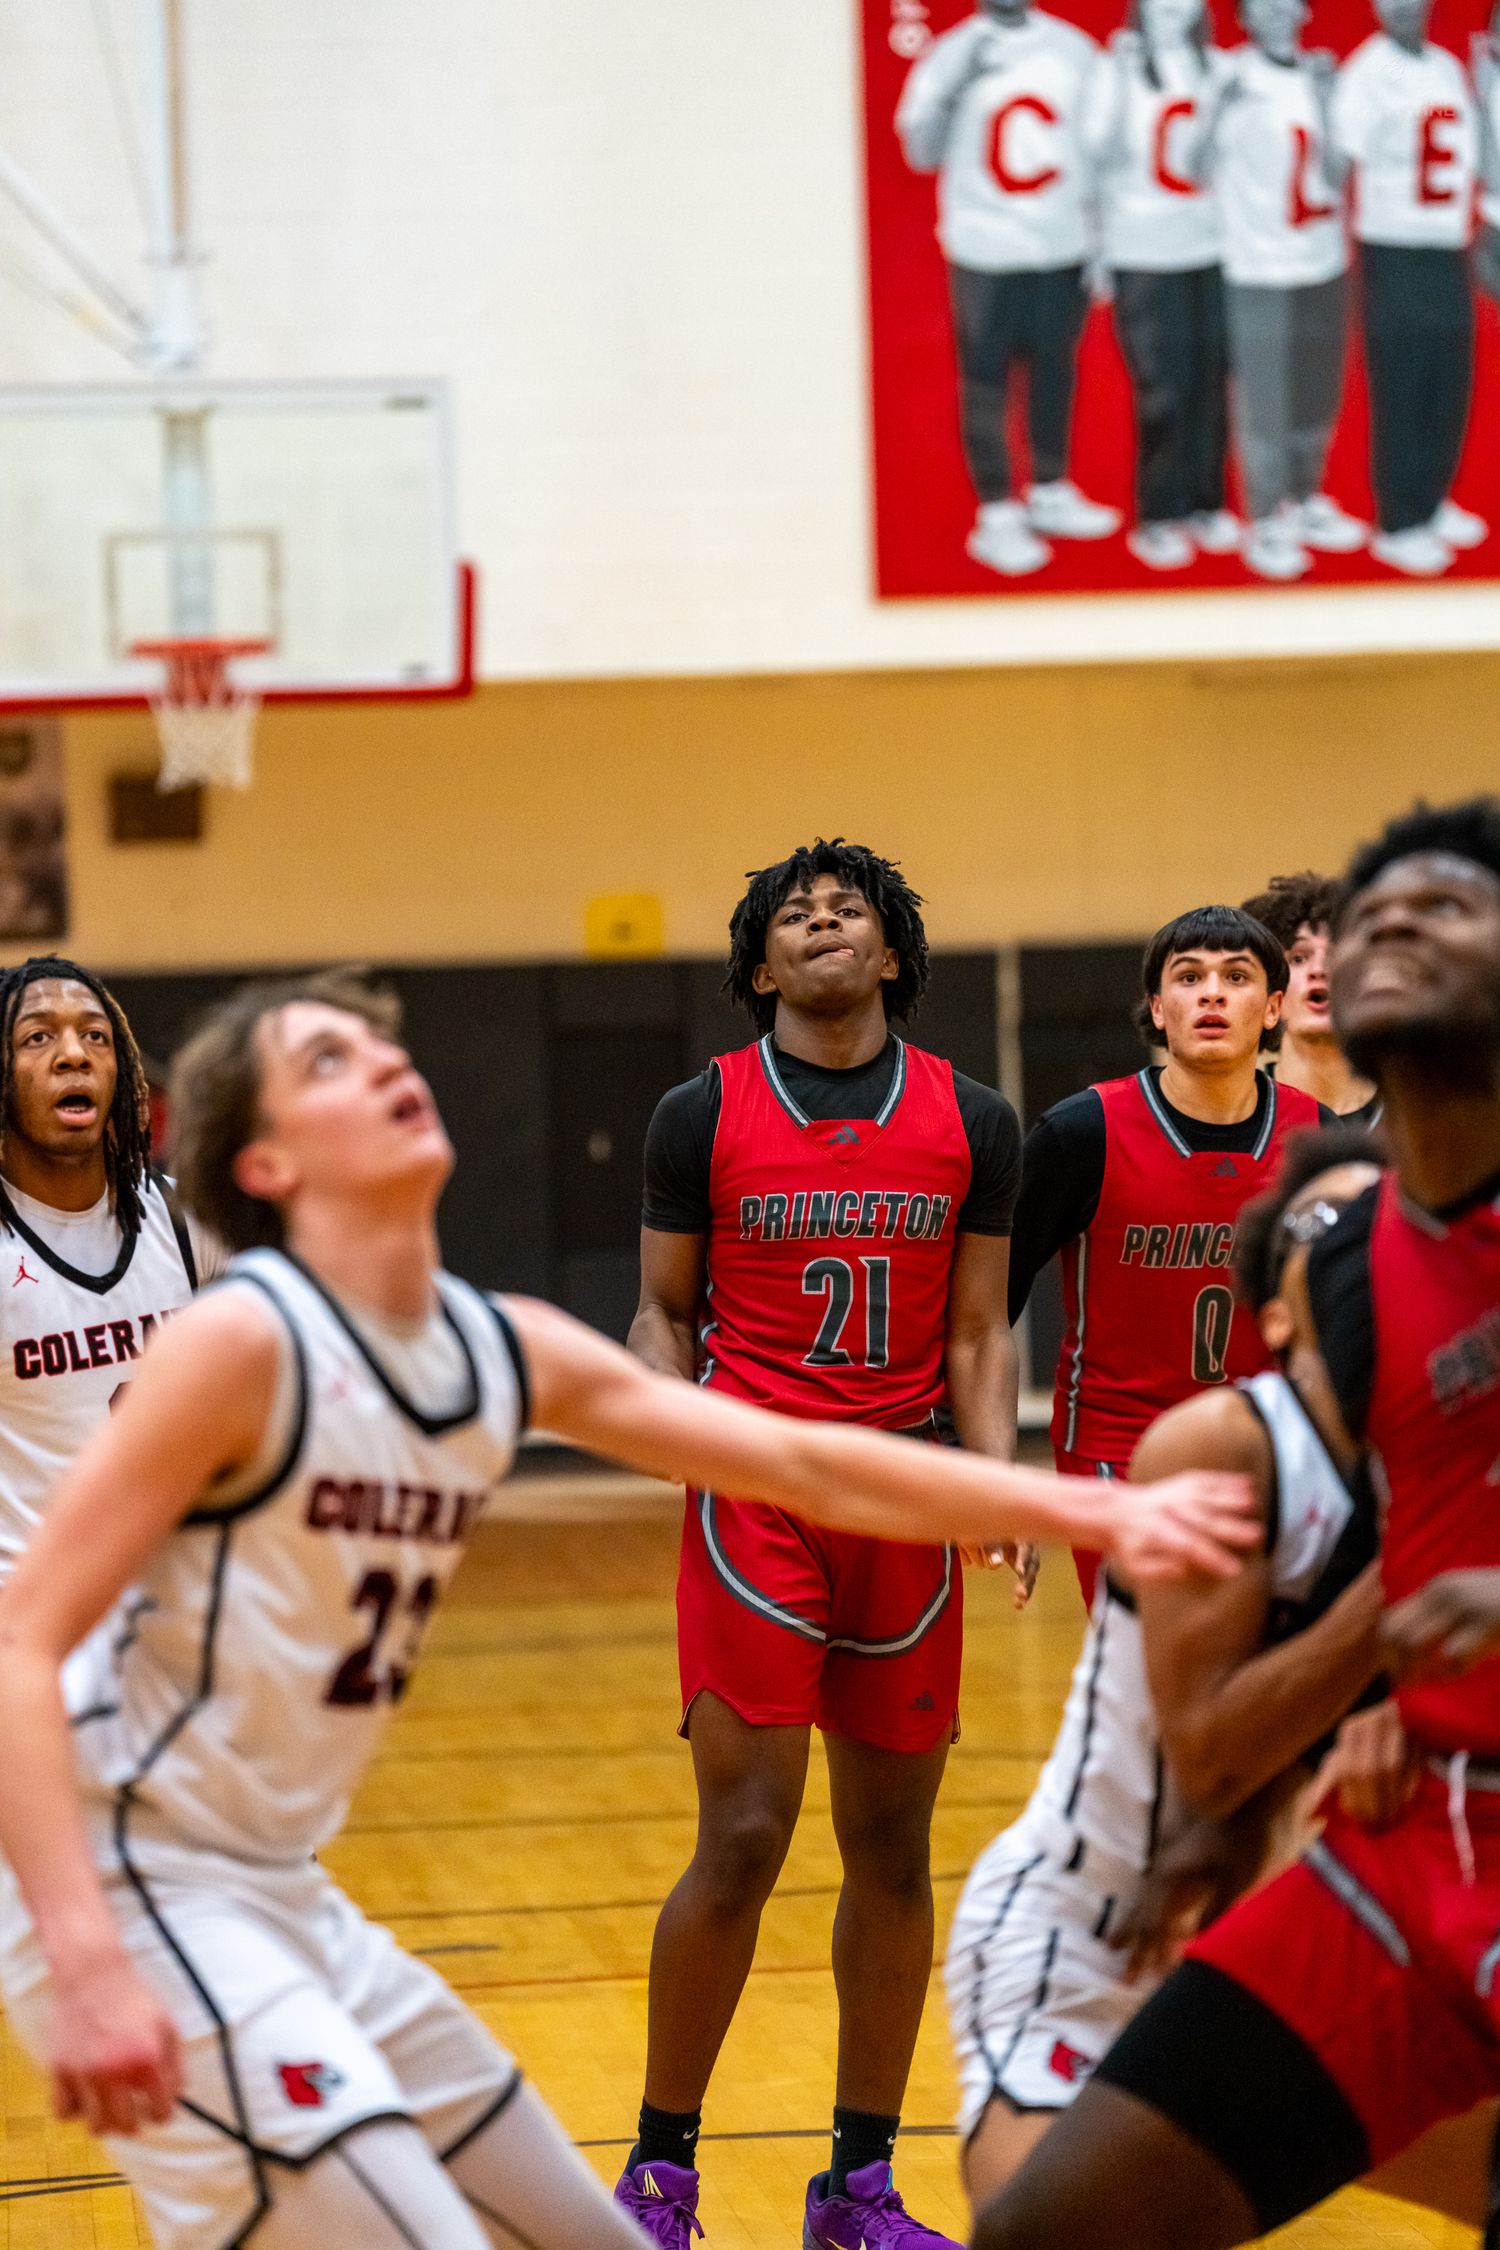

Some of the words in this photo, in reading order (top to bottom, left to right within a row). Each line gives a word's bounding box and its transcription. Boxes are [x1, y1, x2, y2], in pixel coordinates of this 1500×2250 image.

[985, 94, 1057, 196] C
[1287, 123, 1336, 230] L
[1419, 105, 1459, 204] E
[740, 1191, 951, 1241] PRINCETON
[801, 1256, 890, 1367] 21
[1191, 1284, 1235, 1384] 0
